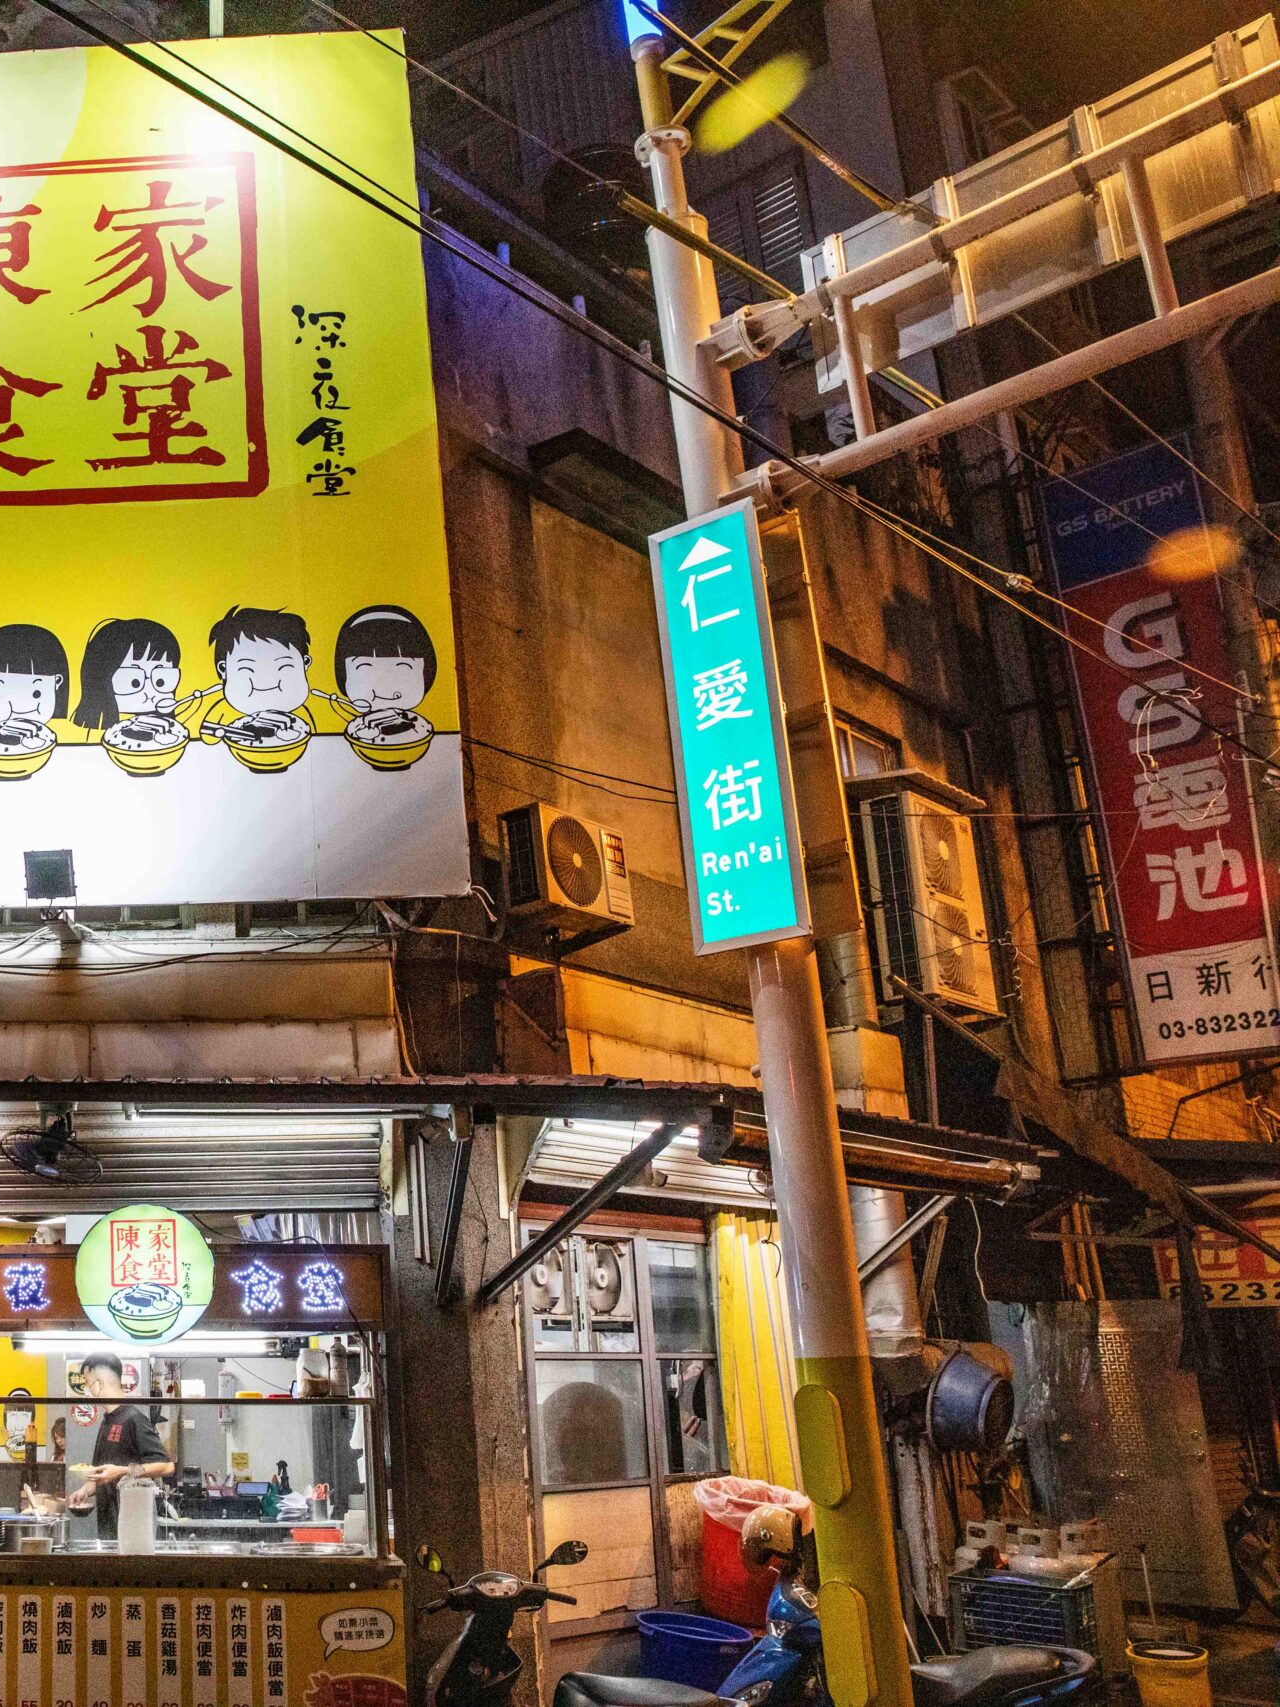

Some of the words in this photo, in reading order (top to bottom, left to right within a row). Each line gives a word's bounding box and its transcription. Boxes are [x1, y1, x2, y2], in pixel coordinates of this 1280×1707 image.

[680, 563, 763, 831] 仁愛街
[702, 836, 783, 876] Ren'ai
[706, 892, 741, 916] St.
[115, 1225, 171, 1252] 陳家
[116, 1253, 171, 1282] 食堂
[22, 1601, 38, 1654] 燒肉飯
[57, 1602, 72, 1655] 滷肉飯
[91, 1602, 107, 1656] 炒麵
[126, 1604, 141, 1657] 蒸蛋
[161, 1604, 177, 1677] 香菇雞湯
[196, 1604, 213, 1677] 控肉便當
[266, 1605, 284, 1697] 滷肉飯便當
